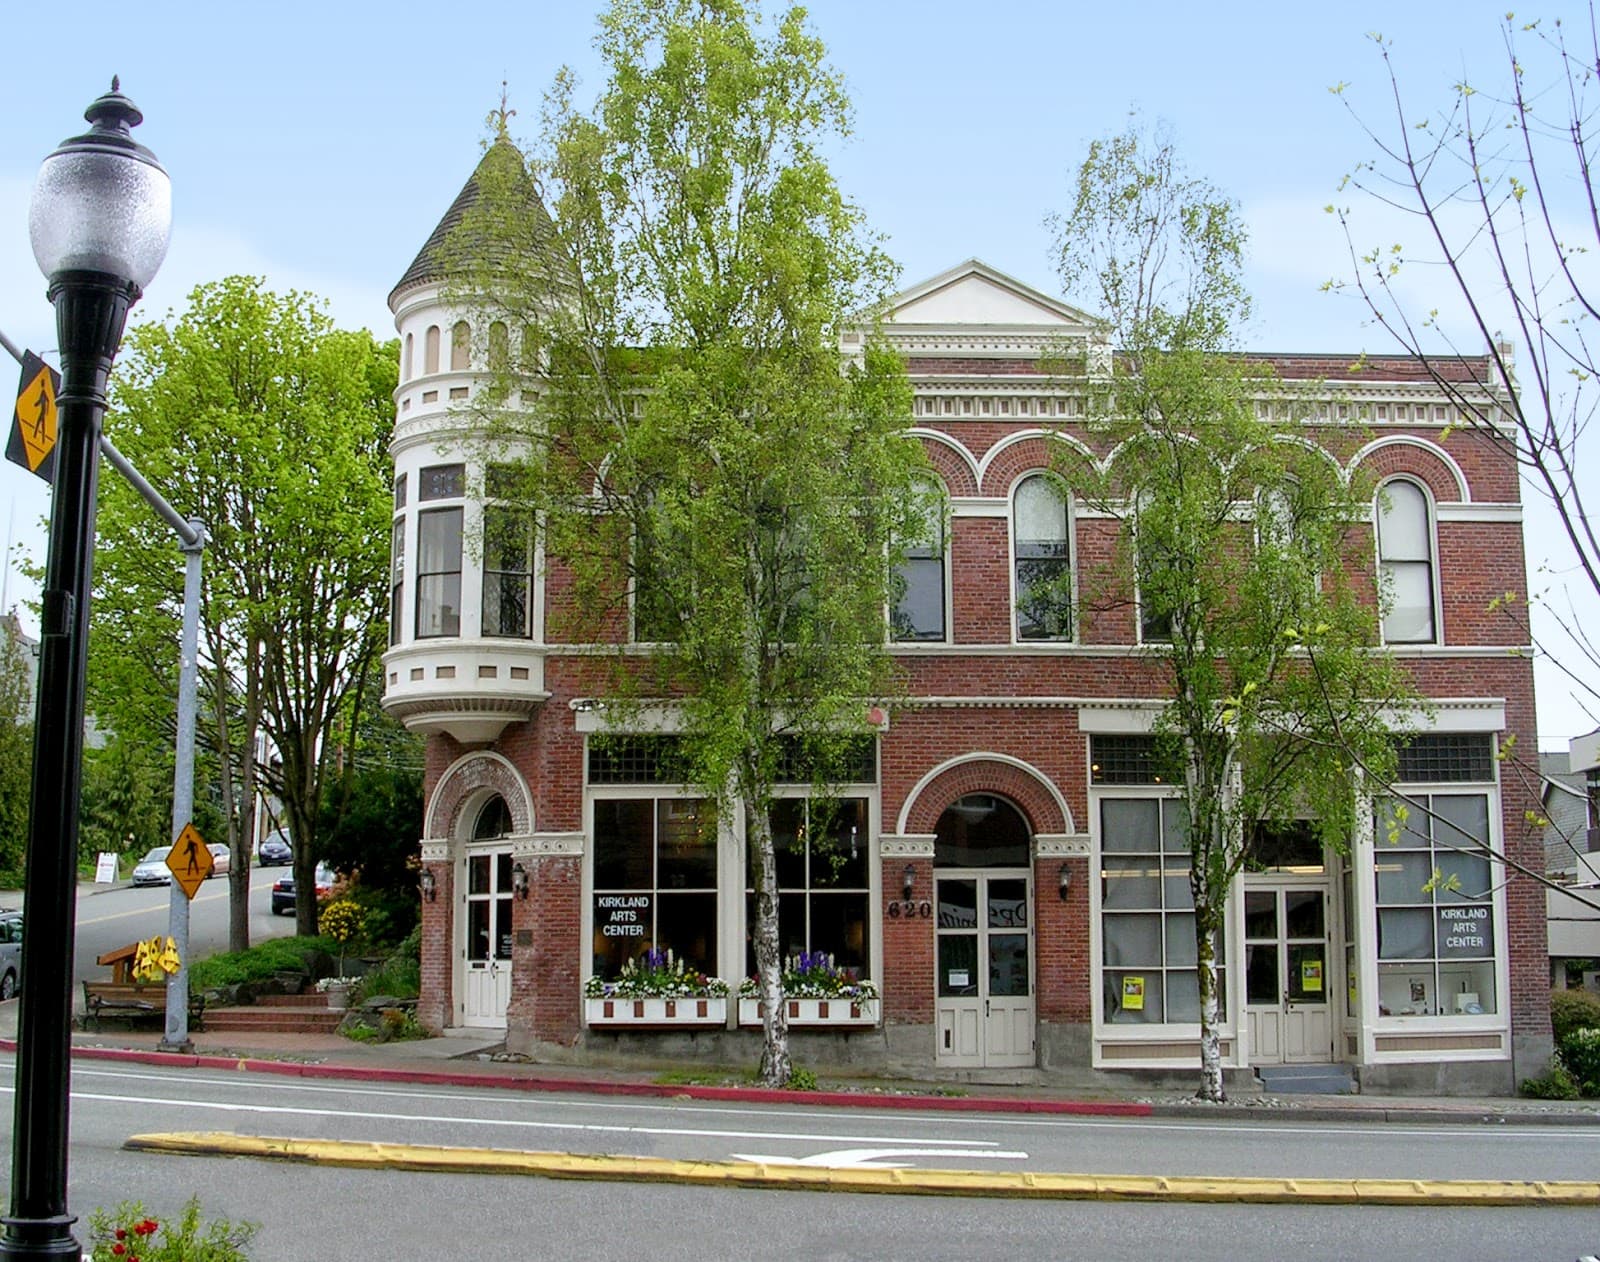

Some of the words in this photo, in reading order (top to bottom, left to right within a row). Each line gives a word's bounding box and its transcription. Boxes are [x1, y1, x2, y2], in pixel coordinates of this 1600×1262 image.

[598, 897, 649, 908] KIRKLAND
[888, 902, 931, 918] 620
[1441, 908, 1487, 919] KIRKLAND
[610, 911, 637, 922] ARTS
[603, 925, 643, 936] CENTER
[1452, 922, 1477, 933] ARTS
[1446, 936, 1484, 947] CENTER
